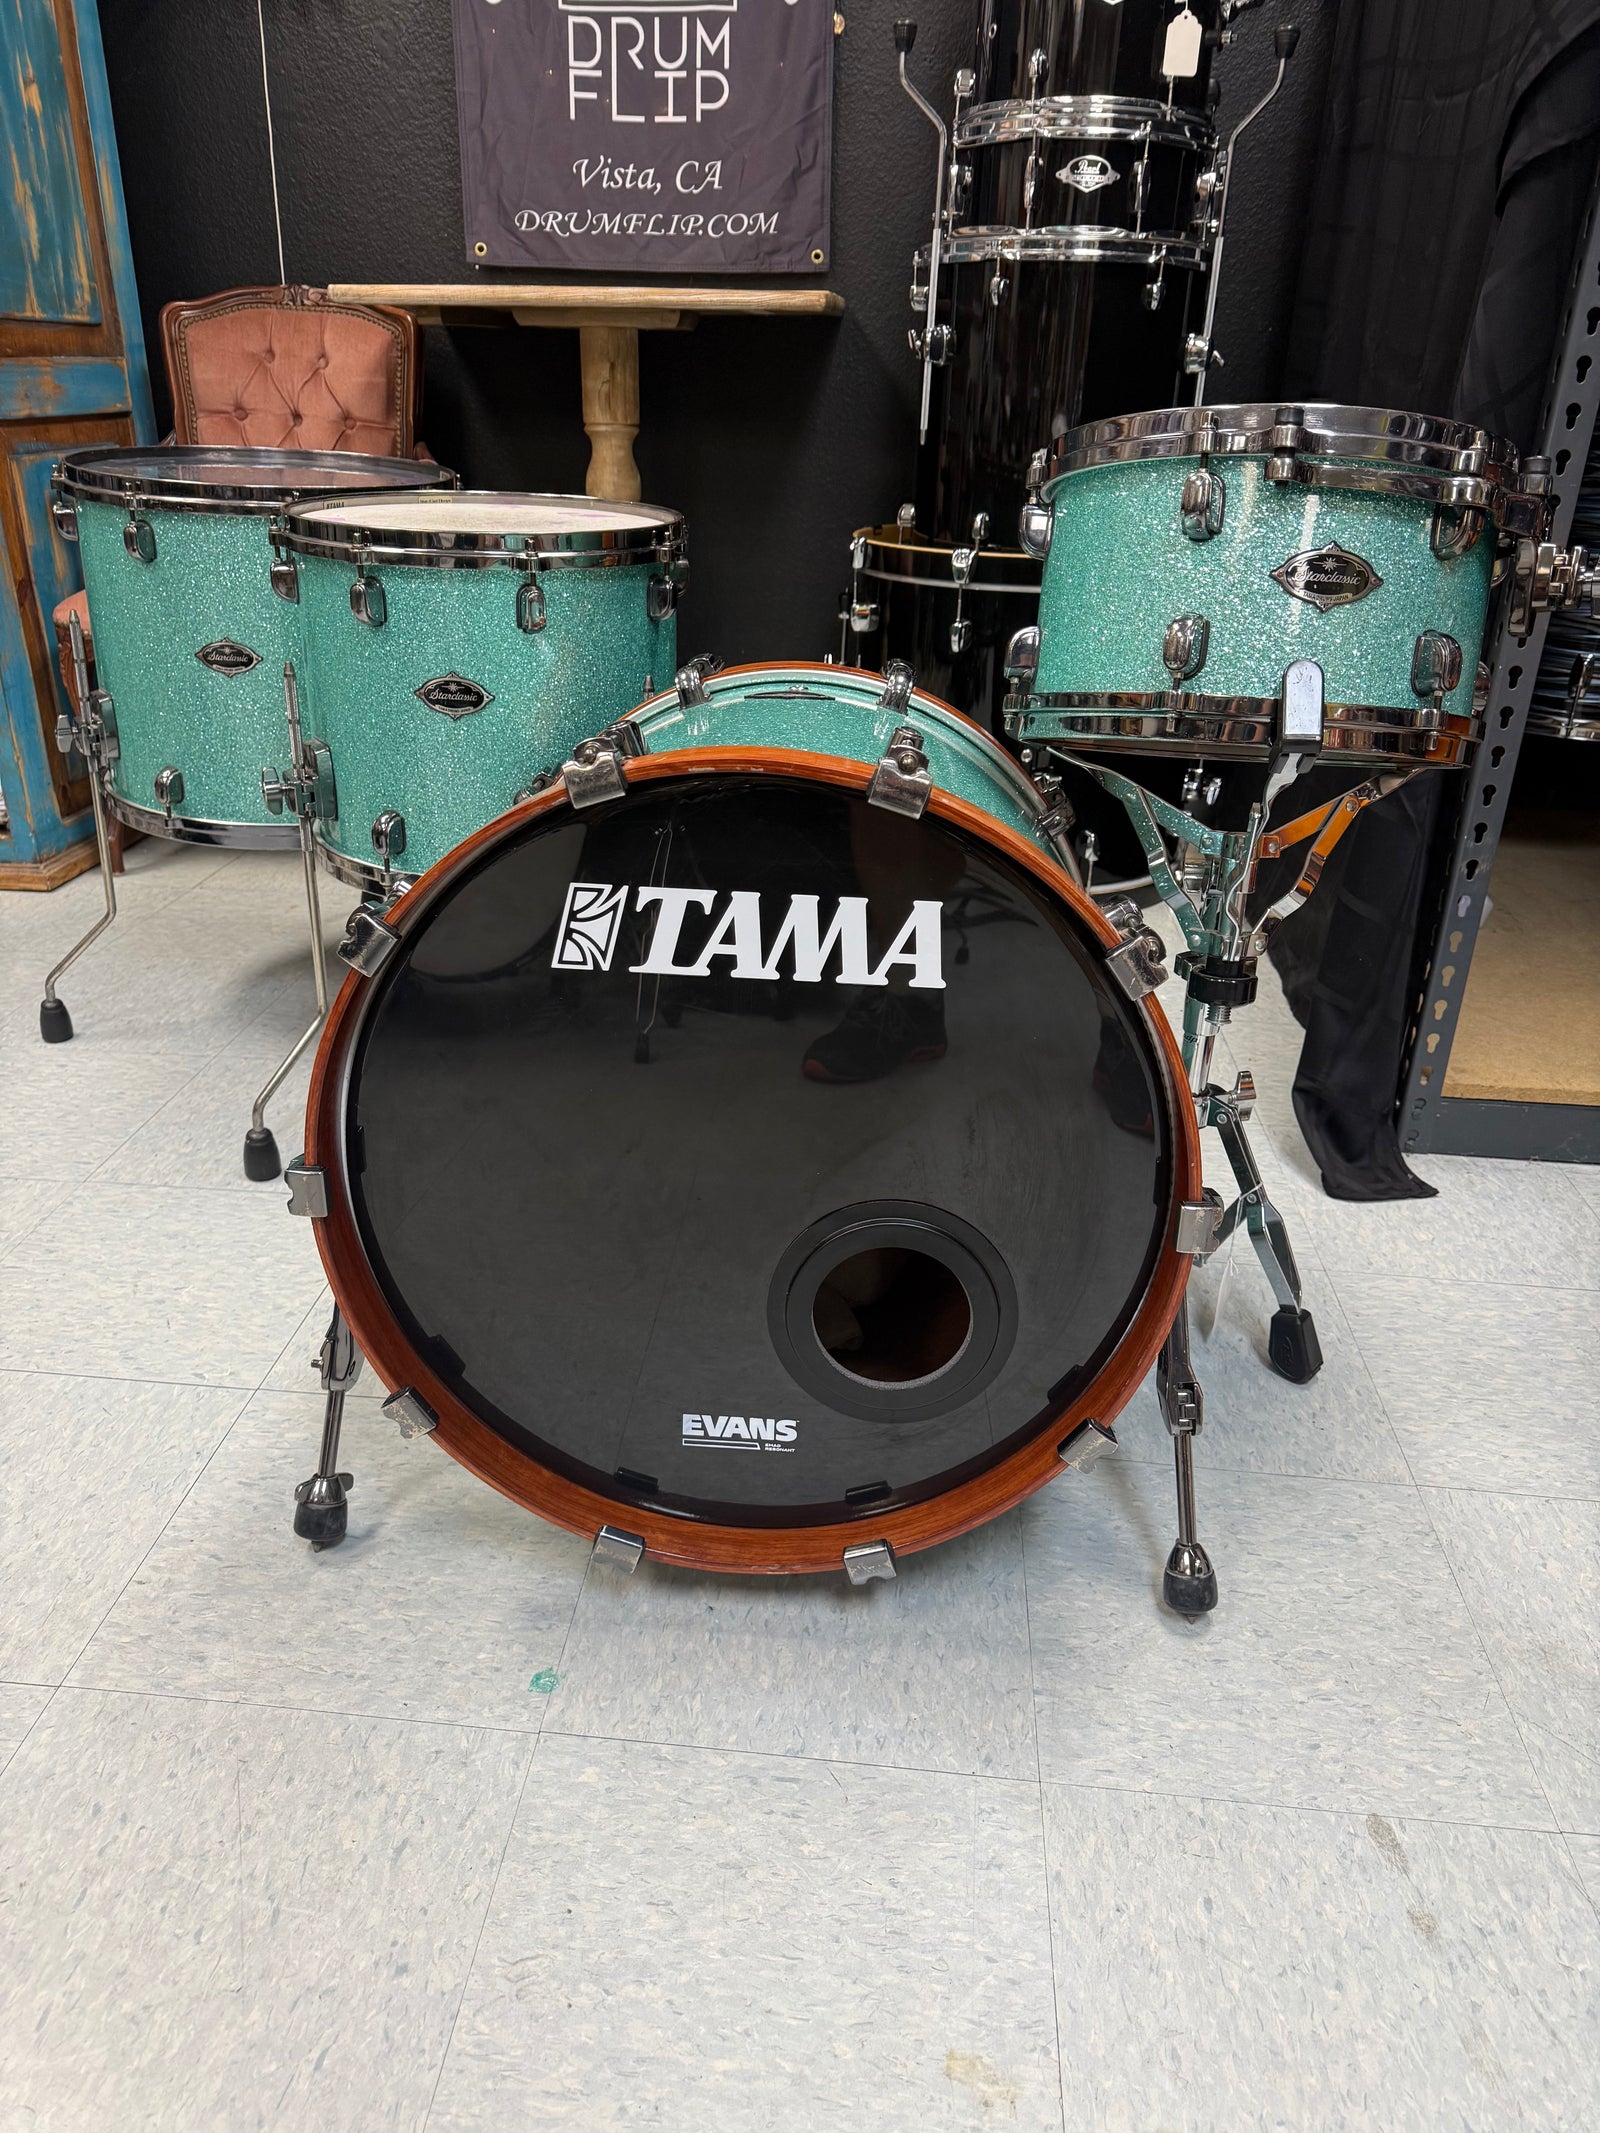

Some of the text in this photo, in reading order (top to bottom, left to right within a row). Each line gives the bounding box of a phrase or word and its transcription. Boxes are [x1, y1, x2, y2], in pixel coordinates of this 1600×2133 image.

[568, 15, 731, 70] DRUM
[569, 67, 731, 123] FLIP
[573, 155, 723, 194] Vista, CA
[514, 209, 779, 238] DRUMFLIP.COM
[1292, 561, 1361, 585] Starclassic
[207, 650, 249, 662] Starclassic
[428, 688, 478, 702] Starclassic
[629, 886, 947, 989] TAMA
[682, 1413, 798, 1442] EVANS
